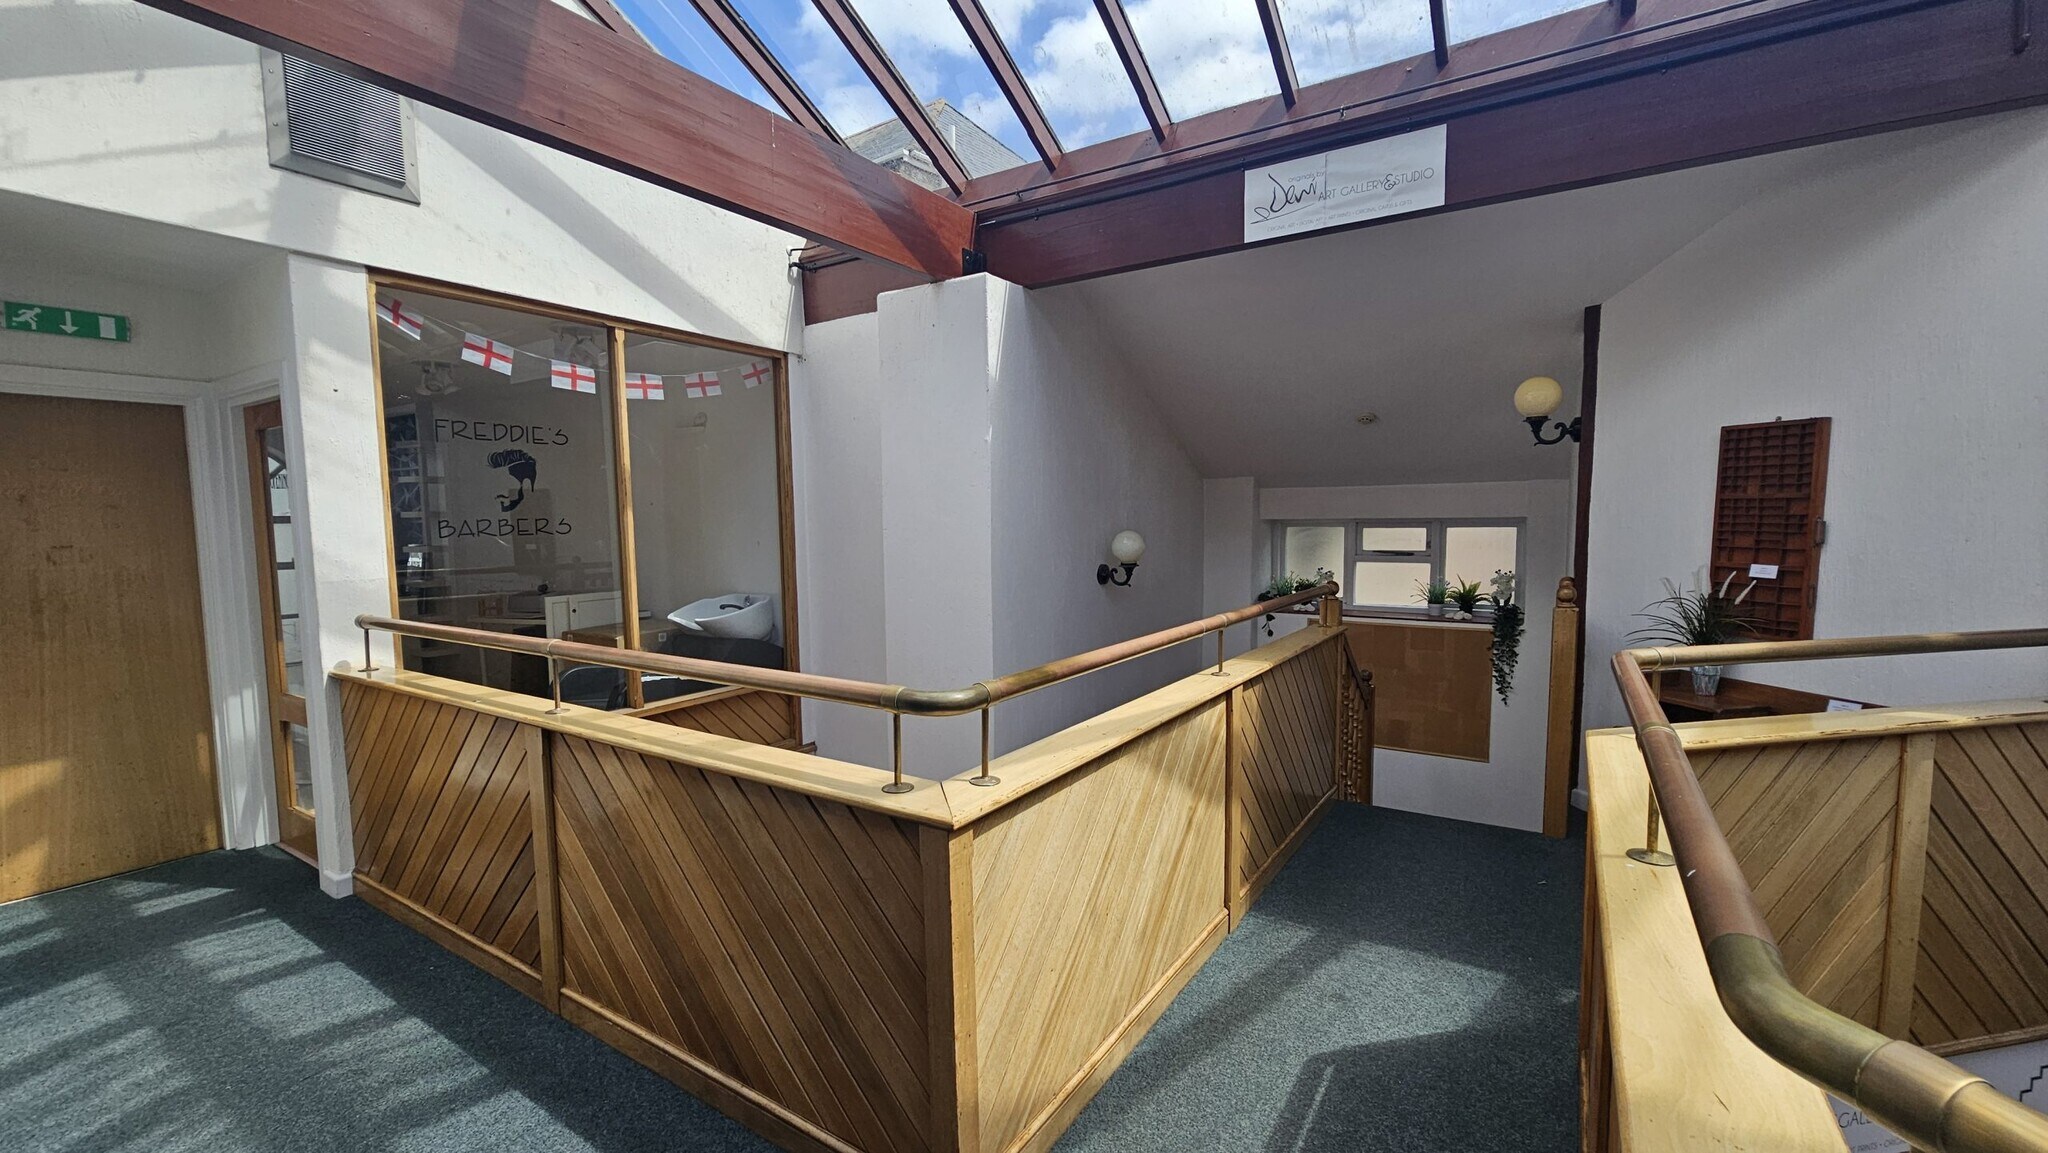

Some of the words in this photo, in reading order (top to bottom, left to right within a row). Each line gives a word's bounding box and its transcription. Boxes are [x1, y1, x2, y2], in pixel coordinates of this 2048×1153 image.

[1318, 188, 1337, 201] ART
[1340, 178, 1385, 197] GALLERY
[1394, 167, 1434, 186] STUDIO
[434, 418, 569, 446] FREDDIE'S
[438, 517, 572, 539] BARBERS
